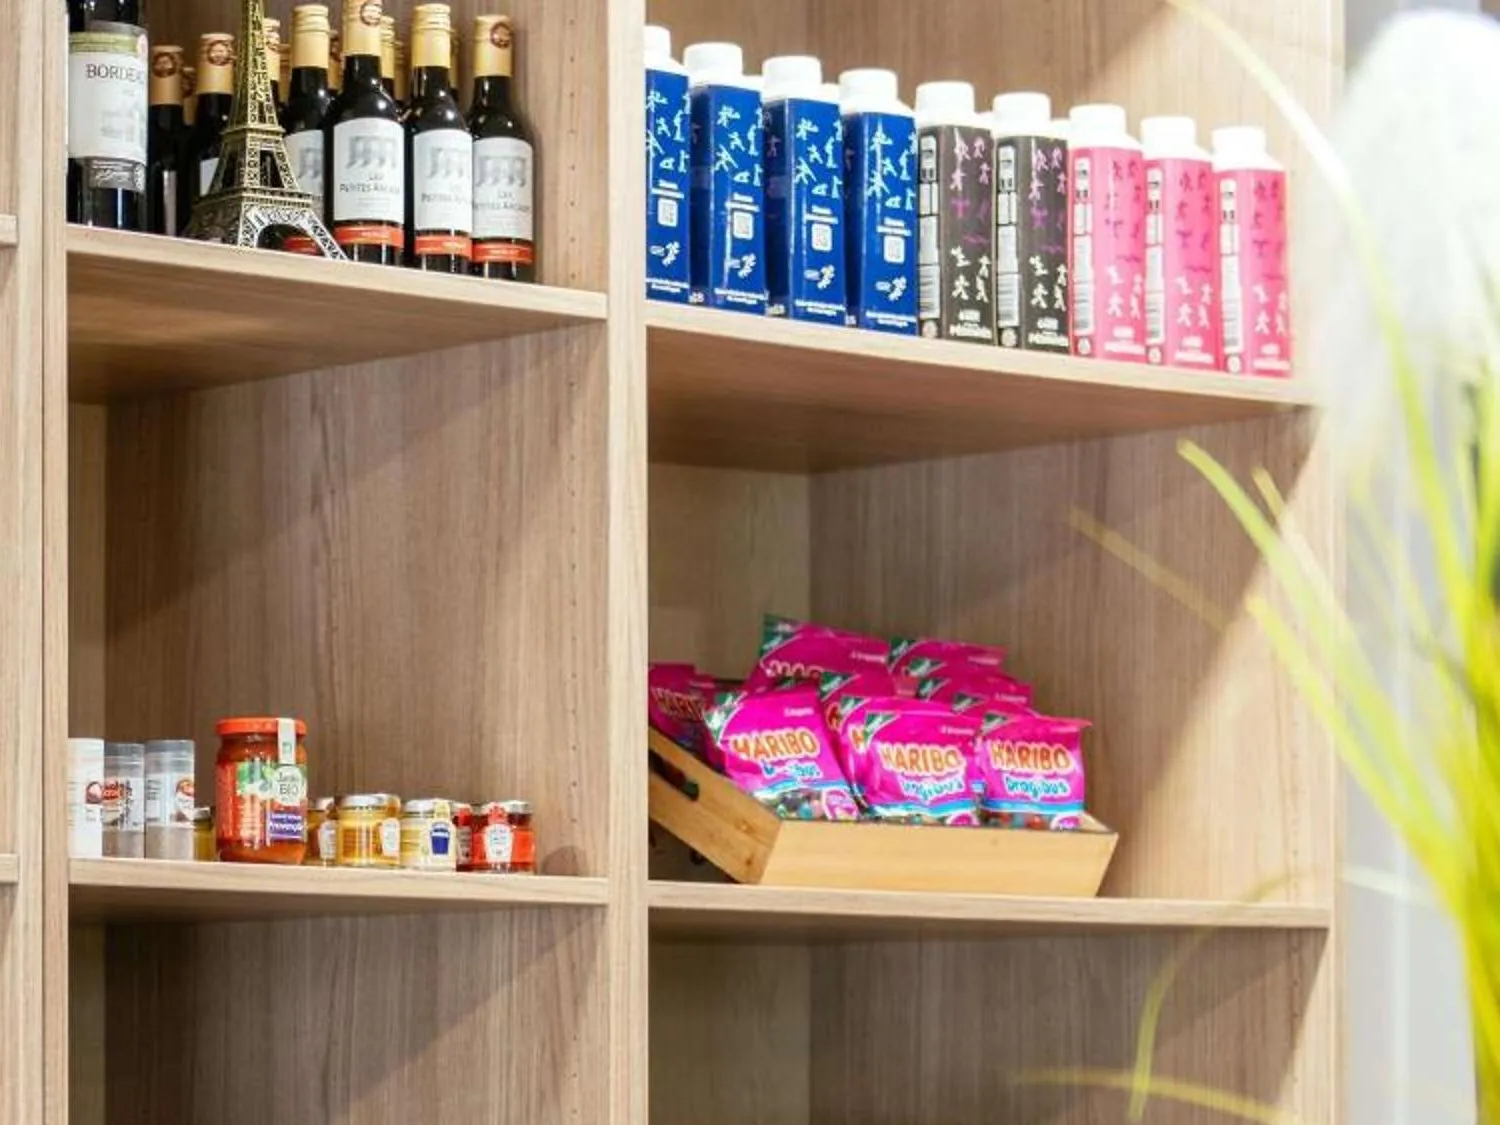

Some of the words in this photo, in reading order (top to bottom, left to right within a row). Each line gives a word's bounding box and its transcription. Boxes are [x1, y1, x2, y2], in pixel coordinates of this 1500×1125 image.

[729, 728, 820, 764] HARIBO
[878, 743, 966, 775] HARIBO
[988, 741, 1074, 773] HARIBO
